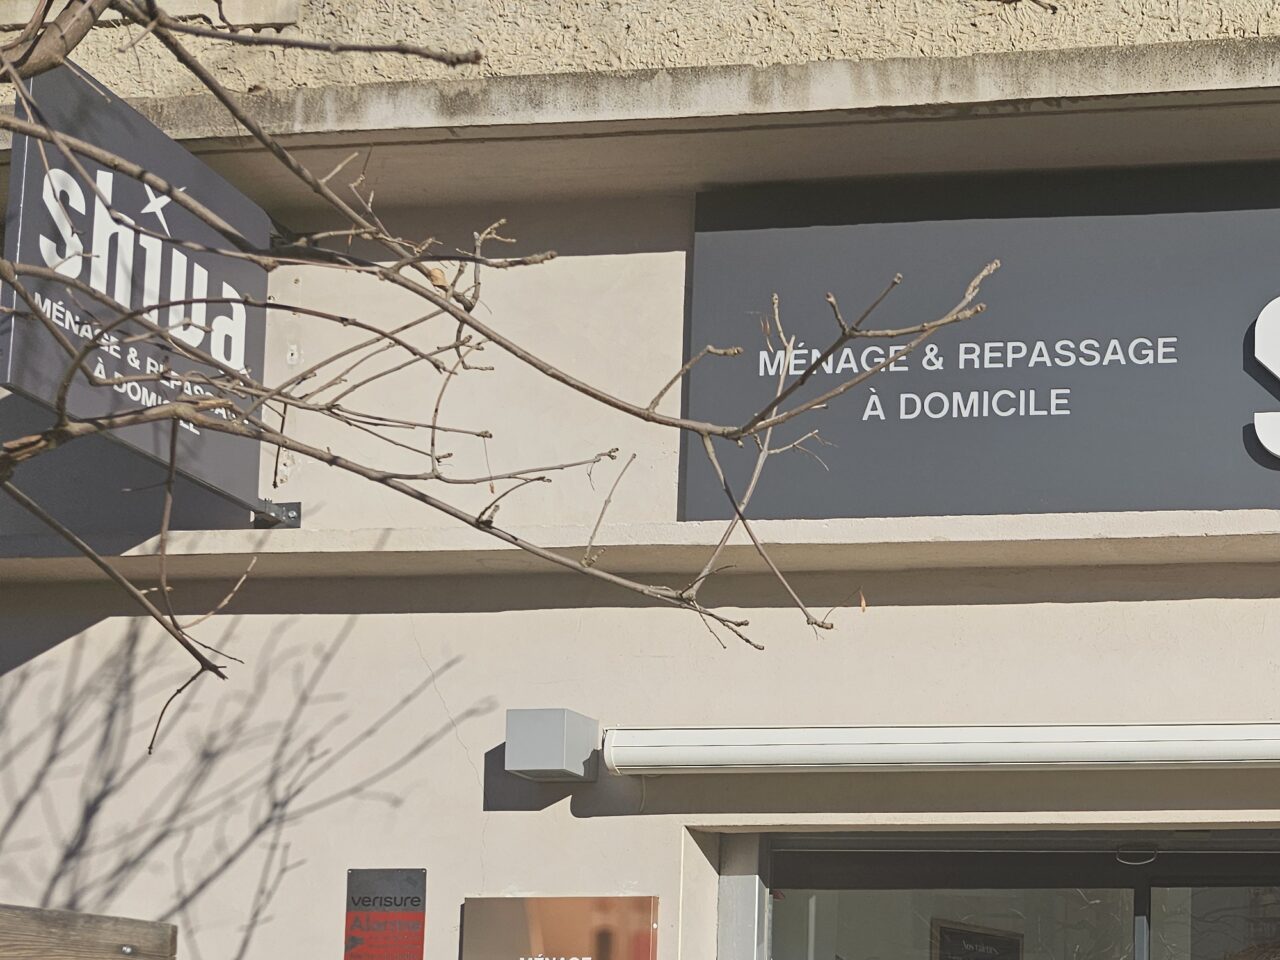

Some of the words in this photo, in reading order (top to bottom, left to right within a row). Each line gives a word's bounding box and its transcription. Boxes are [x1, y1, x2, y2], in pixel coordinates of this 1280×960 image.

[127, 347, 140, 371] &
[758, 342, 909, 376] MÉNAGE
[921, 343, 944, 371] &
[958, 337, 1178, 369] REPASSAGE
[862, 388, 886, 420] À
[900, 388, 1071, 420] DOMICILE
[351, 896, 421, 907] verisure
